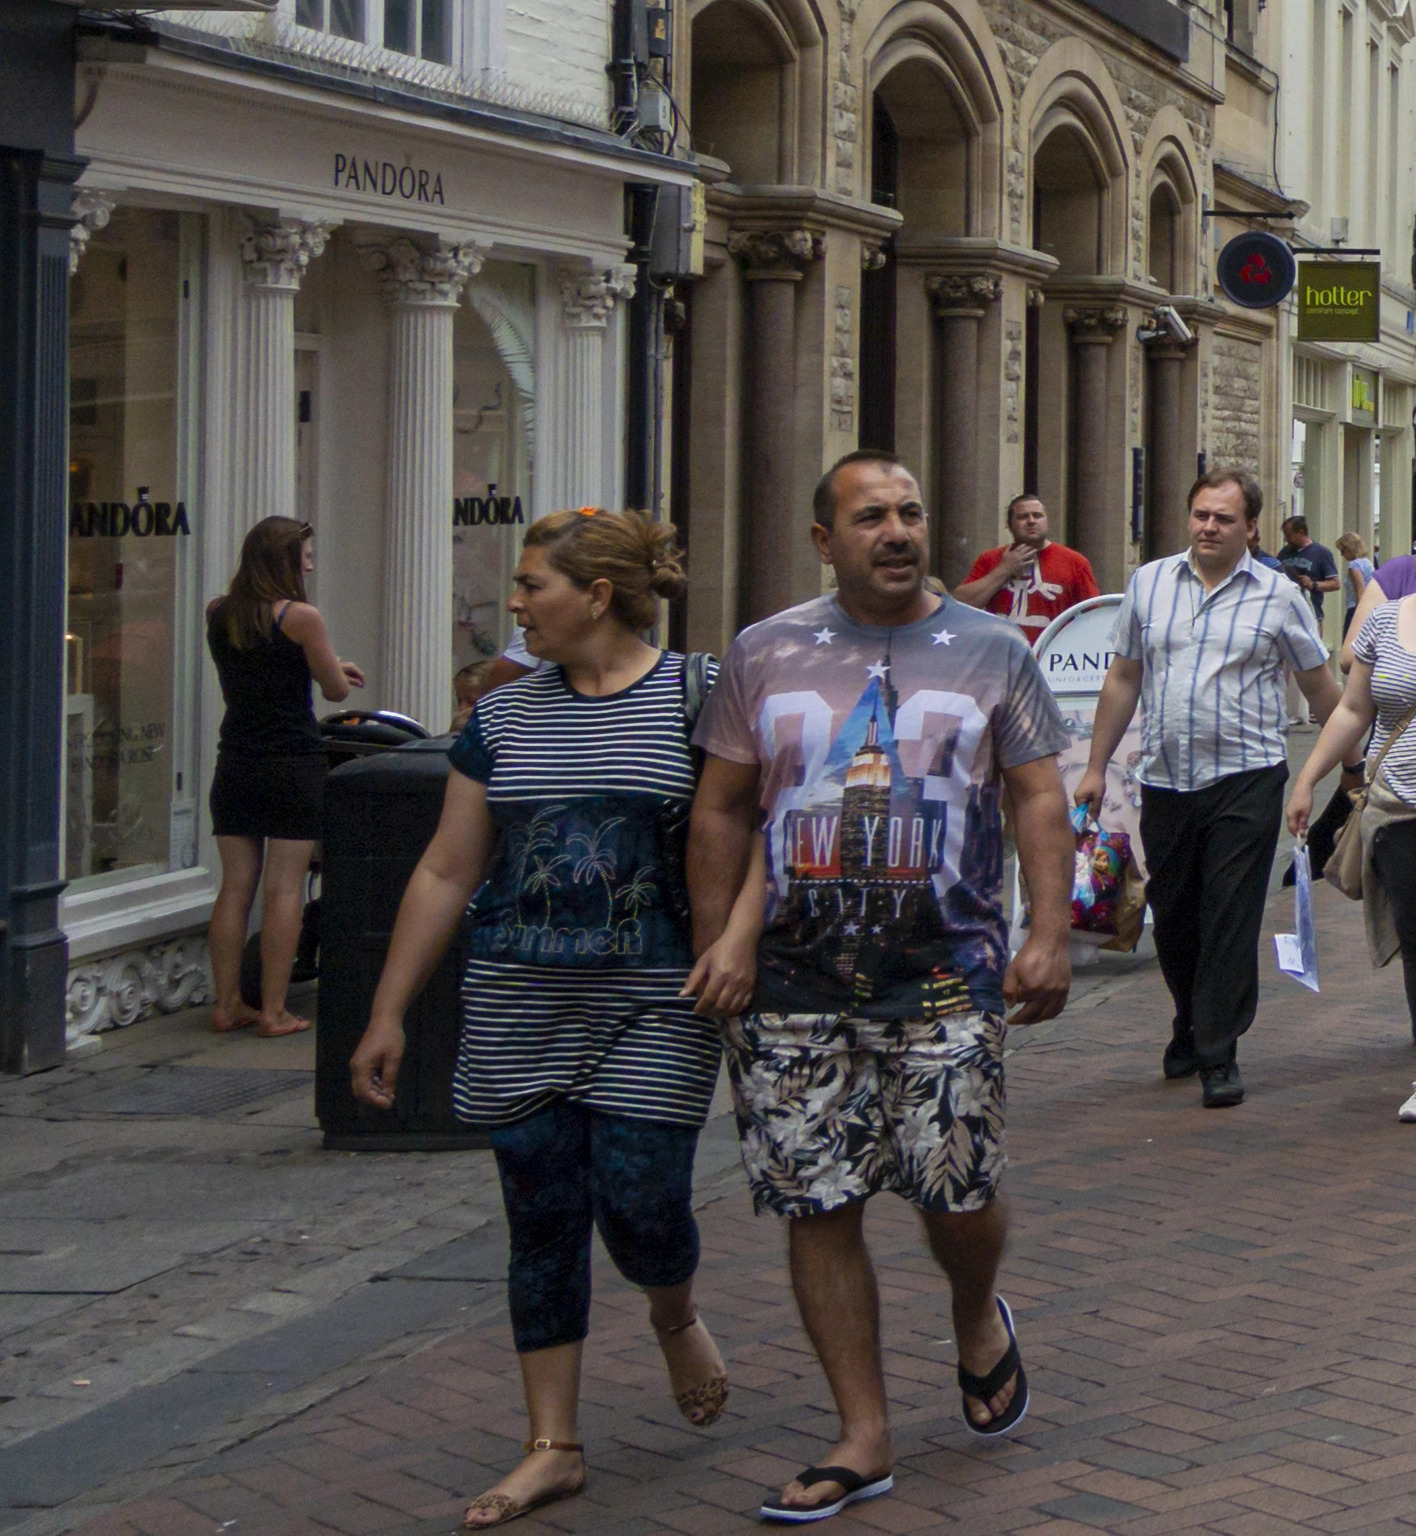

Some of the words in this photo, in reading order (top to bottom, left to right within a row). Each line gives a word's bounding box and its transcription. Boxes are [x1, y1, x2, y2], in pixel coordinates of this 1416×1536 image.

[333, 153, 445, 205] PANDORA
[1306, 285, 1372, 307] hotter
[71, 500, 191, 537] ANDORA
[453, 495, 525, 528] NDORA
[1049, 651, 1117, 672] PAND
[785, 815, 839, 869] NEW
[863, 816, 943, 869] YORK
